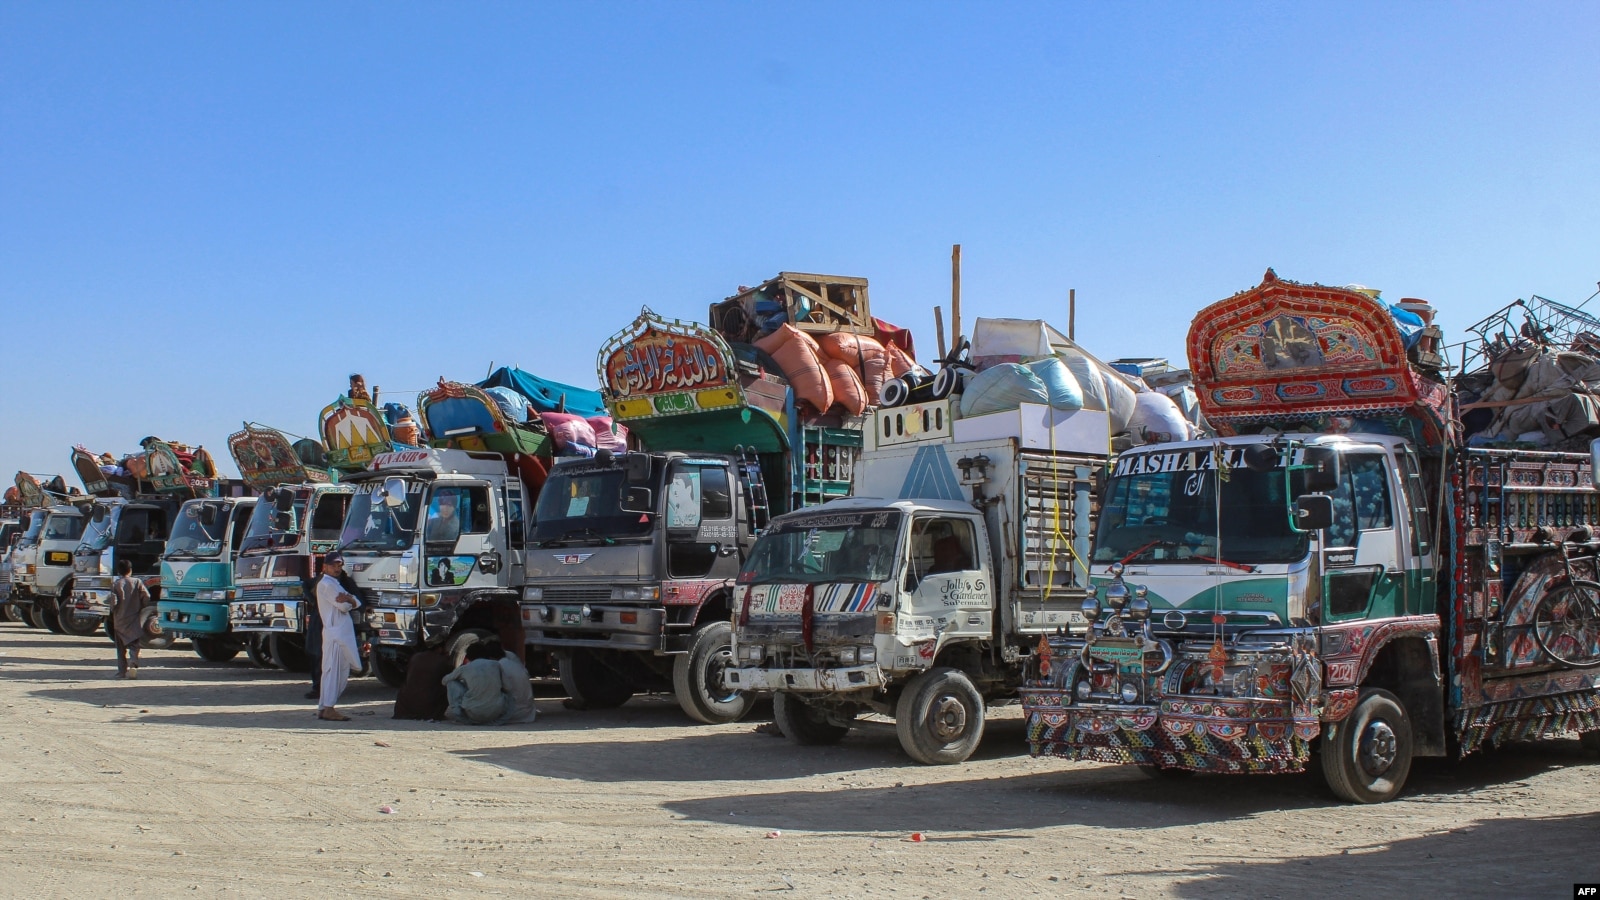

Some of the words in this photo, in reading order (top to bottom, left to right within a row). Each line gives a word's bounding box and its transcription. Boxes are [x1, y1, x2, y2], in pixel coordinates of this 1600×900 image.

[941, 578, 967, 593] Jolly
[950, 589, 988, 600] Gardener
[1330, 664, 1355, 681] 2021
